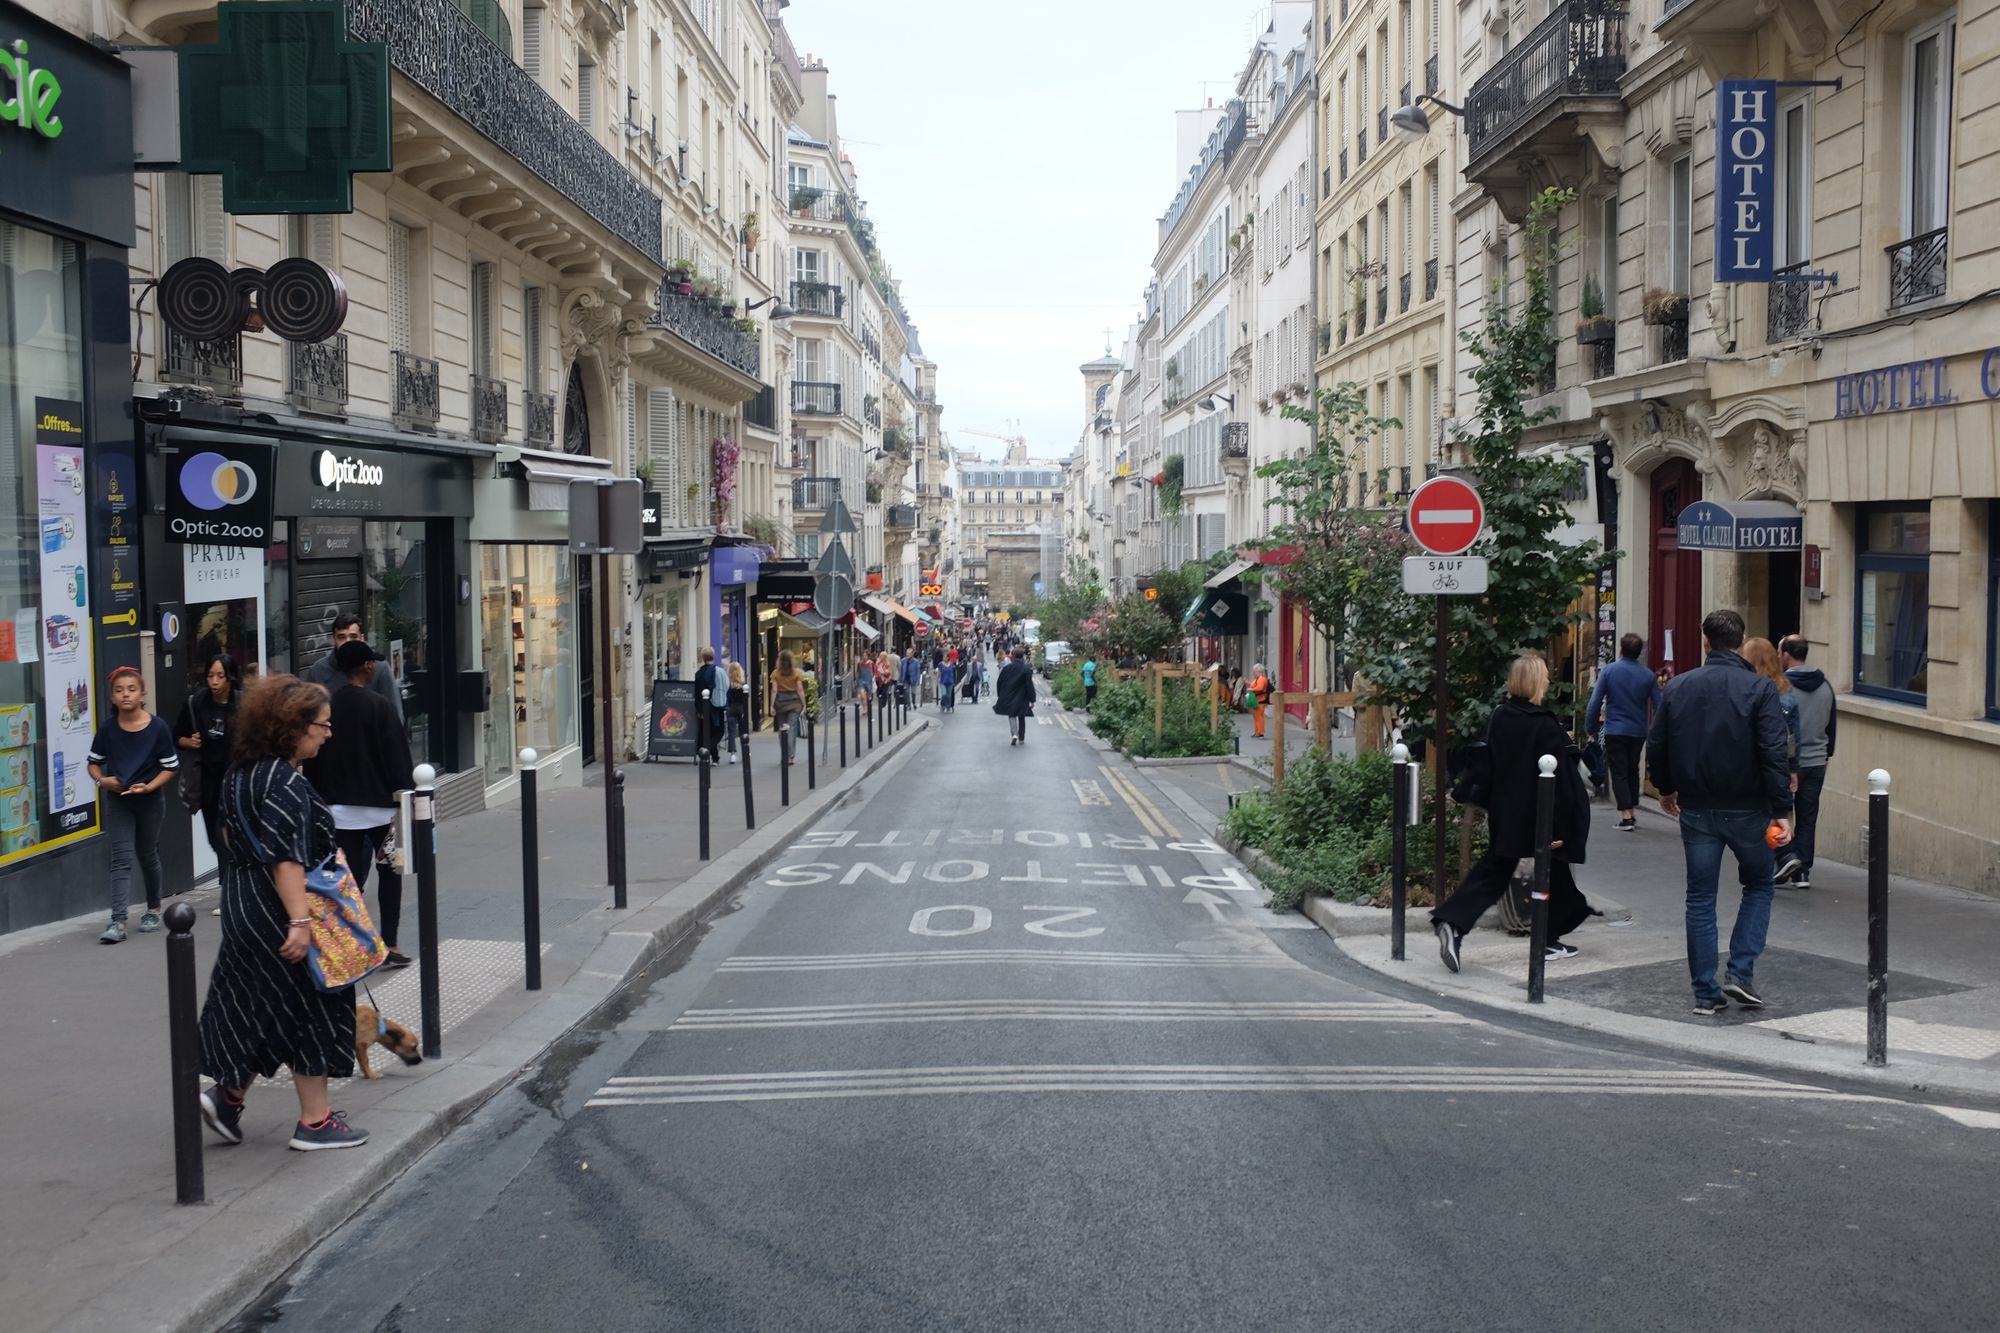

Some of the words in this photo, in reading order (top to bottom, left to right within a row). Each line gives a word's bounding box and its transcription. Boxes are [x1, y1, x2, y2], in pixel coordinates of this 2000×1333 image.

[1730, 90, 1767, 269] HOTEL
[1834, 357, 1952, 419] HOTEL
[44, 414, 71, 432] Offres
[171, 518, 219, 538] Optic
[221, 522, 264, 539] 2000
[1680, 525, 1701, 545] HOTEL
[1703, 525, 1733, 547] CLAUZEL
[1740, 527, 1801, 547] HOTEL
[191, 544, 246, 563] PRADA
[198, 568, 241, 582] EYEWEAR
[1429, 561, 1463, 570] SAUF
[789, 829, 1227, 854] PRIORITE
[765, 859, 1257, 891] PIETONS
[908, 904, 1106, 938] 20
